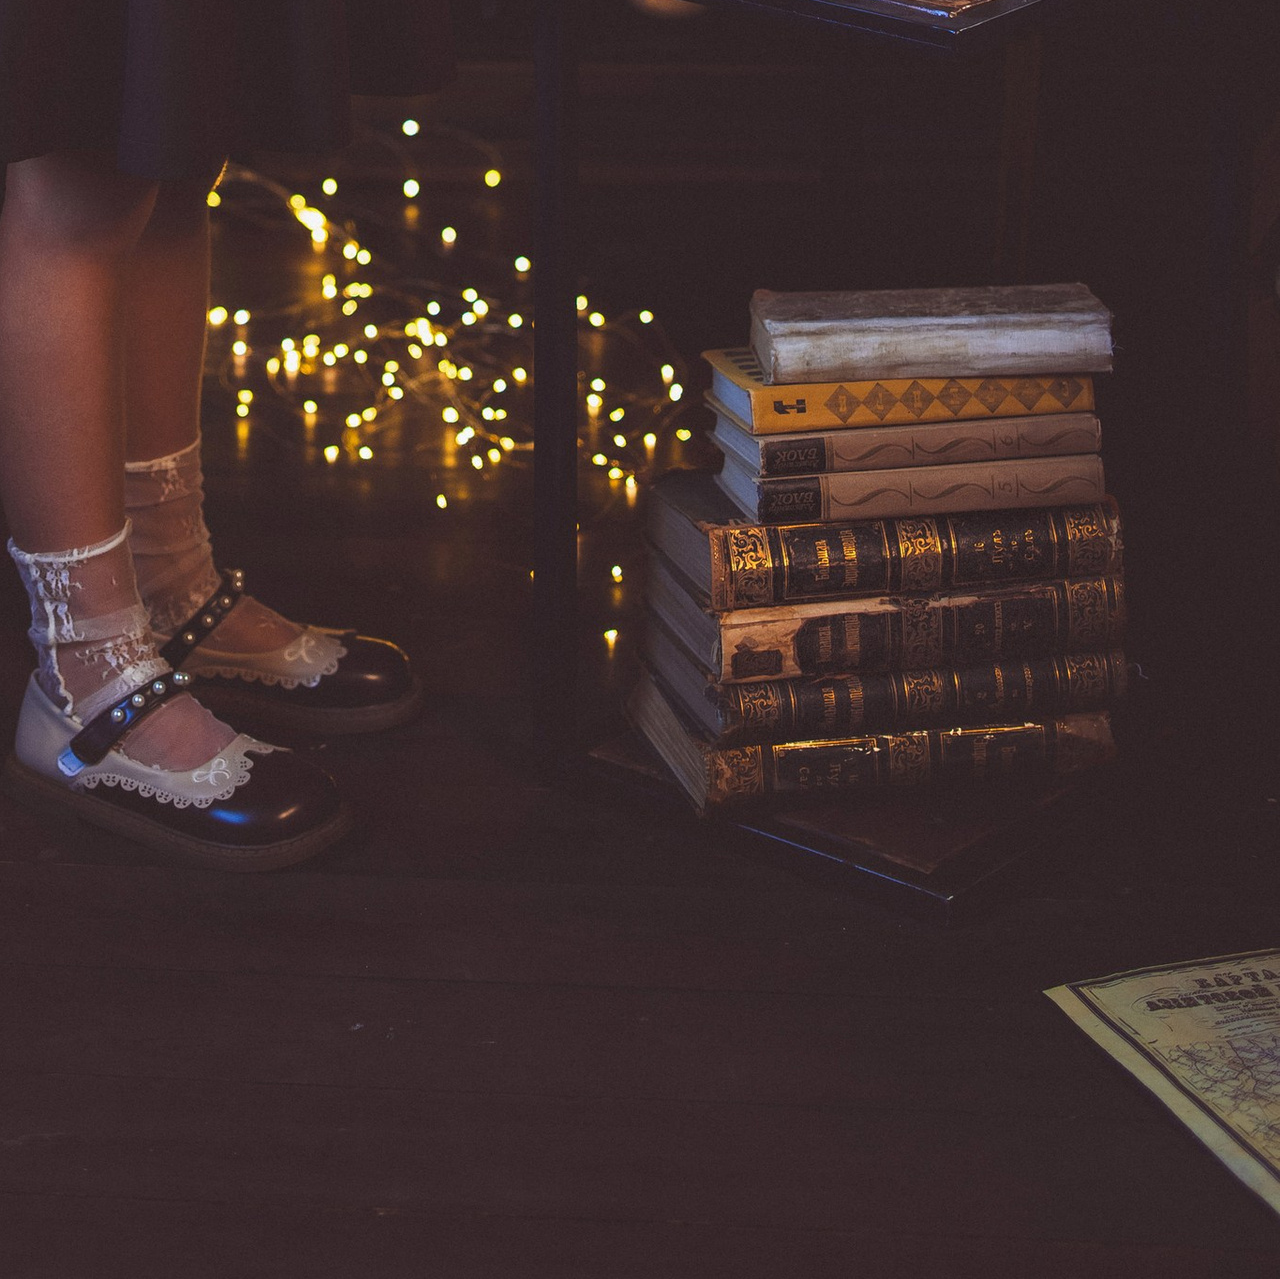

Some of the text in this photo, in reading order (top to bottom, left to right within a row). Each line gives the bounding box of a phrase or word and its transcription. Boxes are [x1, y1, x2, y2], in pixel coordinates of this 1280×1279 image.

[776, 448, 817, 463] БЛОК
[771, 491, 814, 506] БЛОК
[814, 539, 831, 581] Большая
